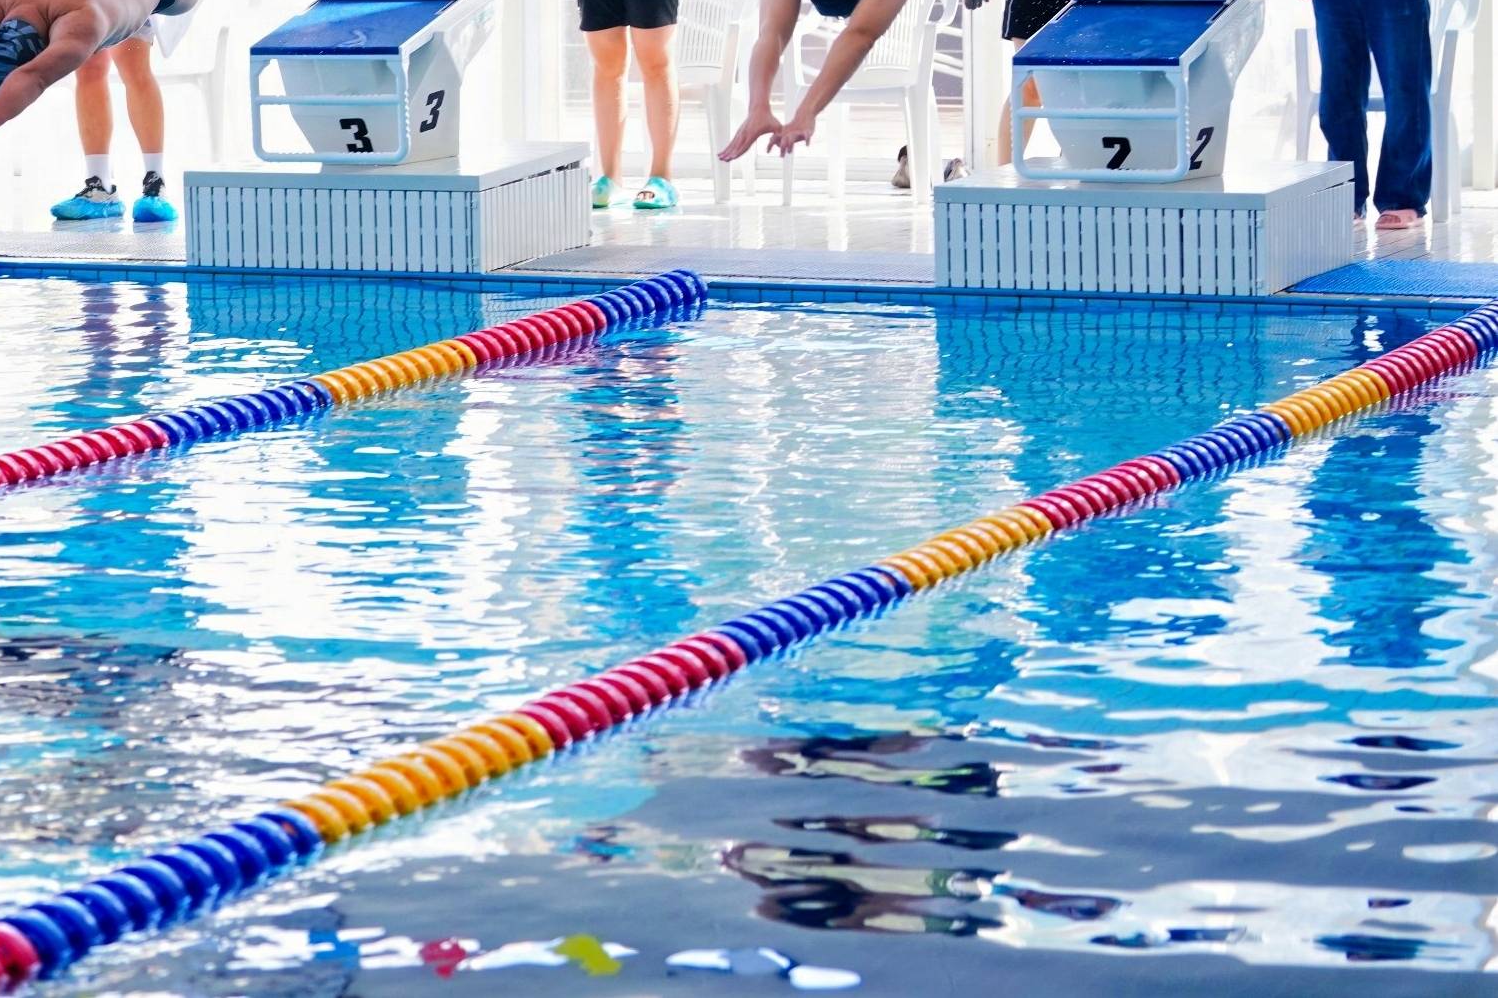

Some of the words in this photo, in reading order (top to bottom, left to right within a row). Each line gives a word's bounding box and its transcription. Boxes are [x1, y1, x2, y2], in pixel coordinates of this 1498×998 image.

[419, 89, 445, 133] 3
[339, 118, 374, 153] 3
[1102, 136, 1132, 171] 2
[1189, 126, 1214, 171] 2
